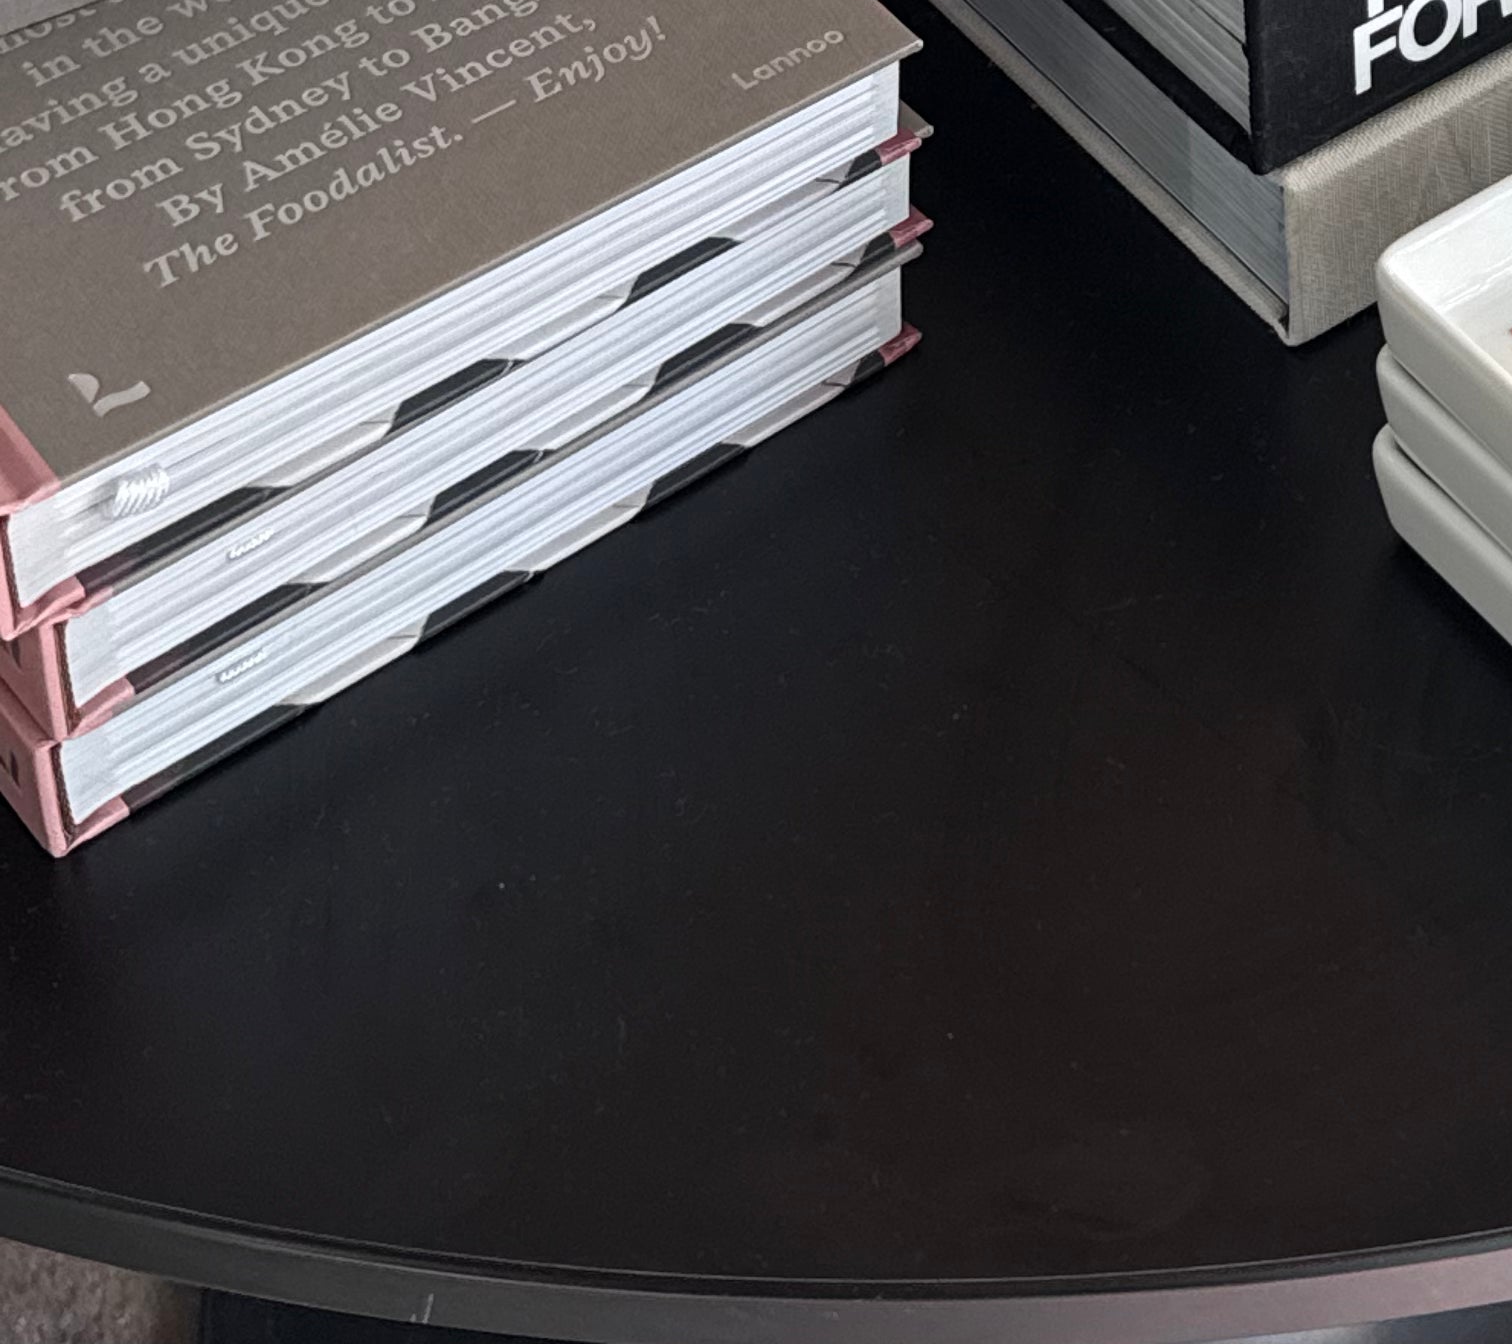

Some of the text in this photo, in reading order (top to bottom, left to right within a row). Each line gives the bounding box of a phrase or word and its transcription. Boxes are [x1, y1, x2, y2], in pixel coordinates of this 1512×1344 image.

[20, 39, 80, 89] in
[79, 6, 164, 56] the
[105, 76, 246, 152] Hong
[238, 20, 371, 90] Kong
[136, 54, 174, 88] a
[155, 10, 599, 236] By Amélie Vincent,
[56, 159, 186, 226] from
[183, 73, 356, 167] Sydney
[343, 42, 411, 81] to
[142, 14, 670, 290] The Foodalist. Enjoy!
